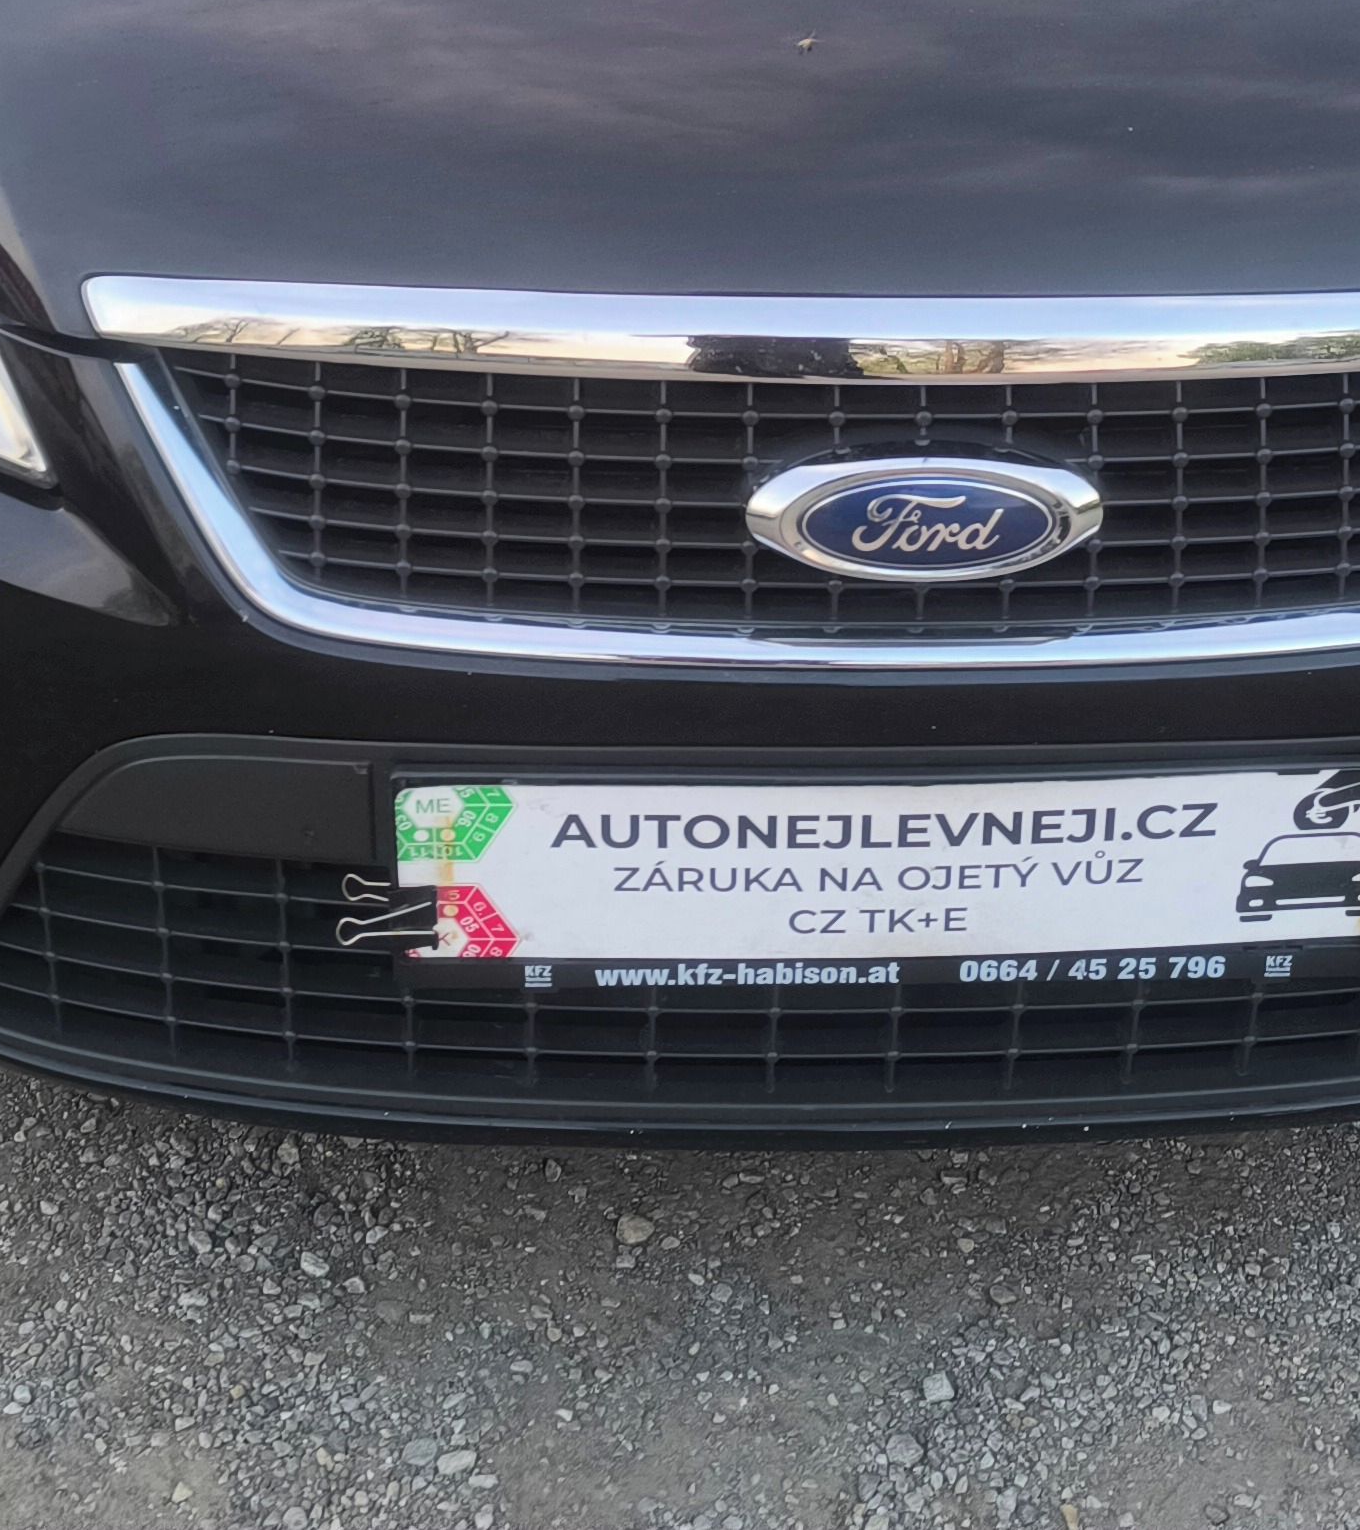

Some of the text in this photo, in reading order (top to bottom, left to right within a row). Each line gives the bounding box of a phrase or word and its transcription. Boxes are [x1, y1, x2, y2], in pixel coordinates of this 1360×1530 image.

[851, 493, 1004, 552] Ford
[415, 798, 451, 814] ME
[550, 802, 1218, 849] AUTONEJLEVNEJI.CZ
[613, 850, 1144, 892] ZÁRUKA NA OJETÝ VŮZ
[789, 907, 968, 934] CZ TK+E
[524, 965, 552, 977] KFZ
[595, 962, 900, 986] www.kfz-habison.at
[959, 955, 1226, 982] 0664 / 45 25 796
[1265, 955, 1293, 967] KFZ
